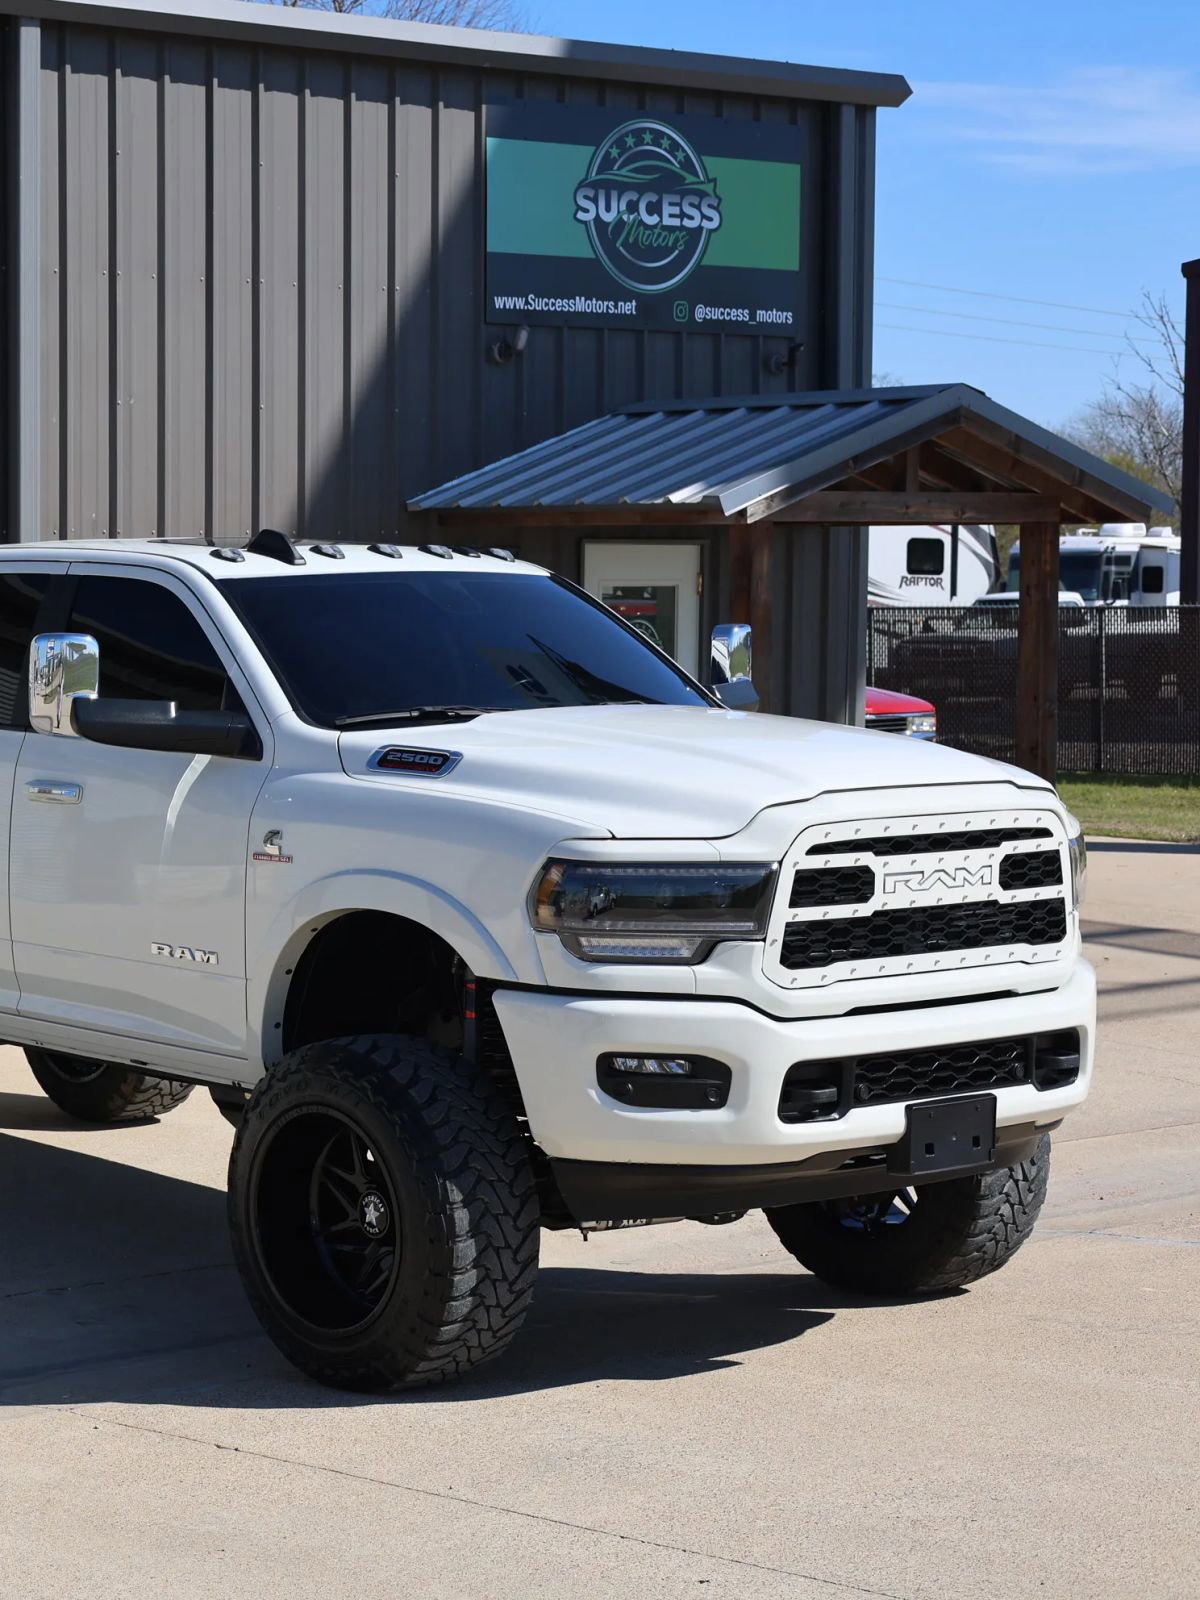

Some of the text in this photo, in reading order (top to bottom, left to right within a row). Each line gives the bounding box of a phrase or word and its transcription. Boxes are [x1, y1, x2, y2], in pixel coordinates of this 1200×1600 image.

[575, 187, 721, 230] SUCCESS
[608, 209, 688, 250] Motors
[494, 294, 636, 315] www.SuccessMotors.net
[695, 304, 793, 325] @success_motors
[899, 575, 945, 591] RAPTOR
[387, 751, 444, 765] 2500
[883, 865, 993, 894] RAM
[151, 941, 219, 965] RAM
